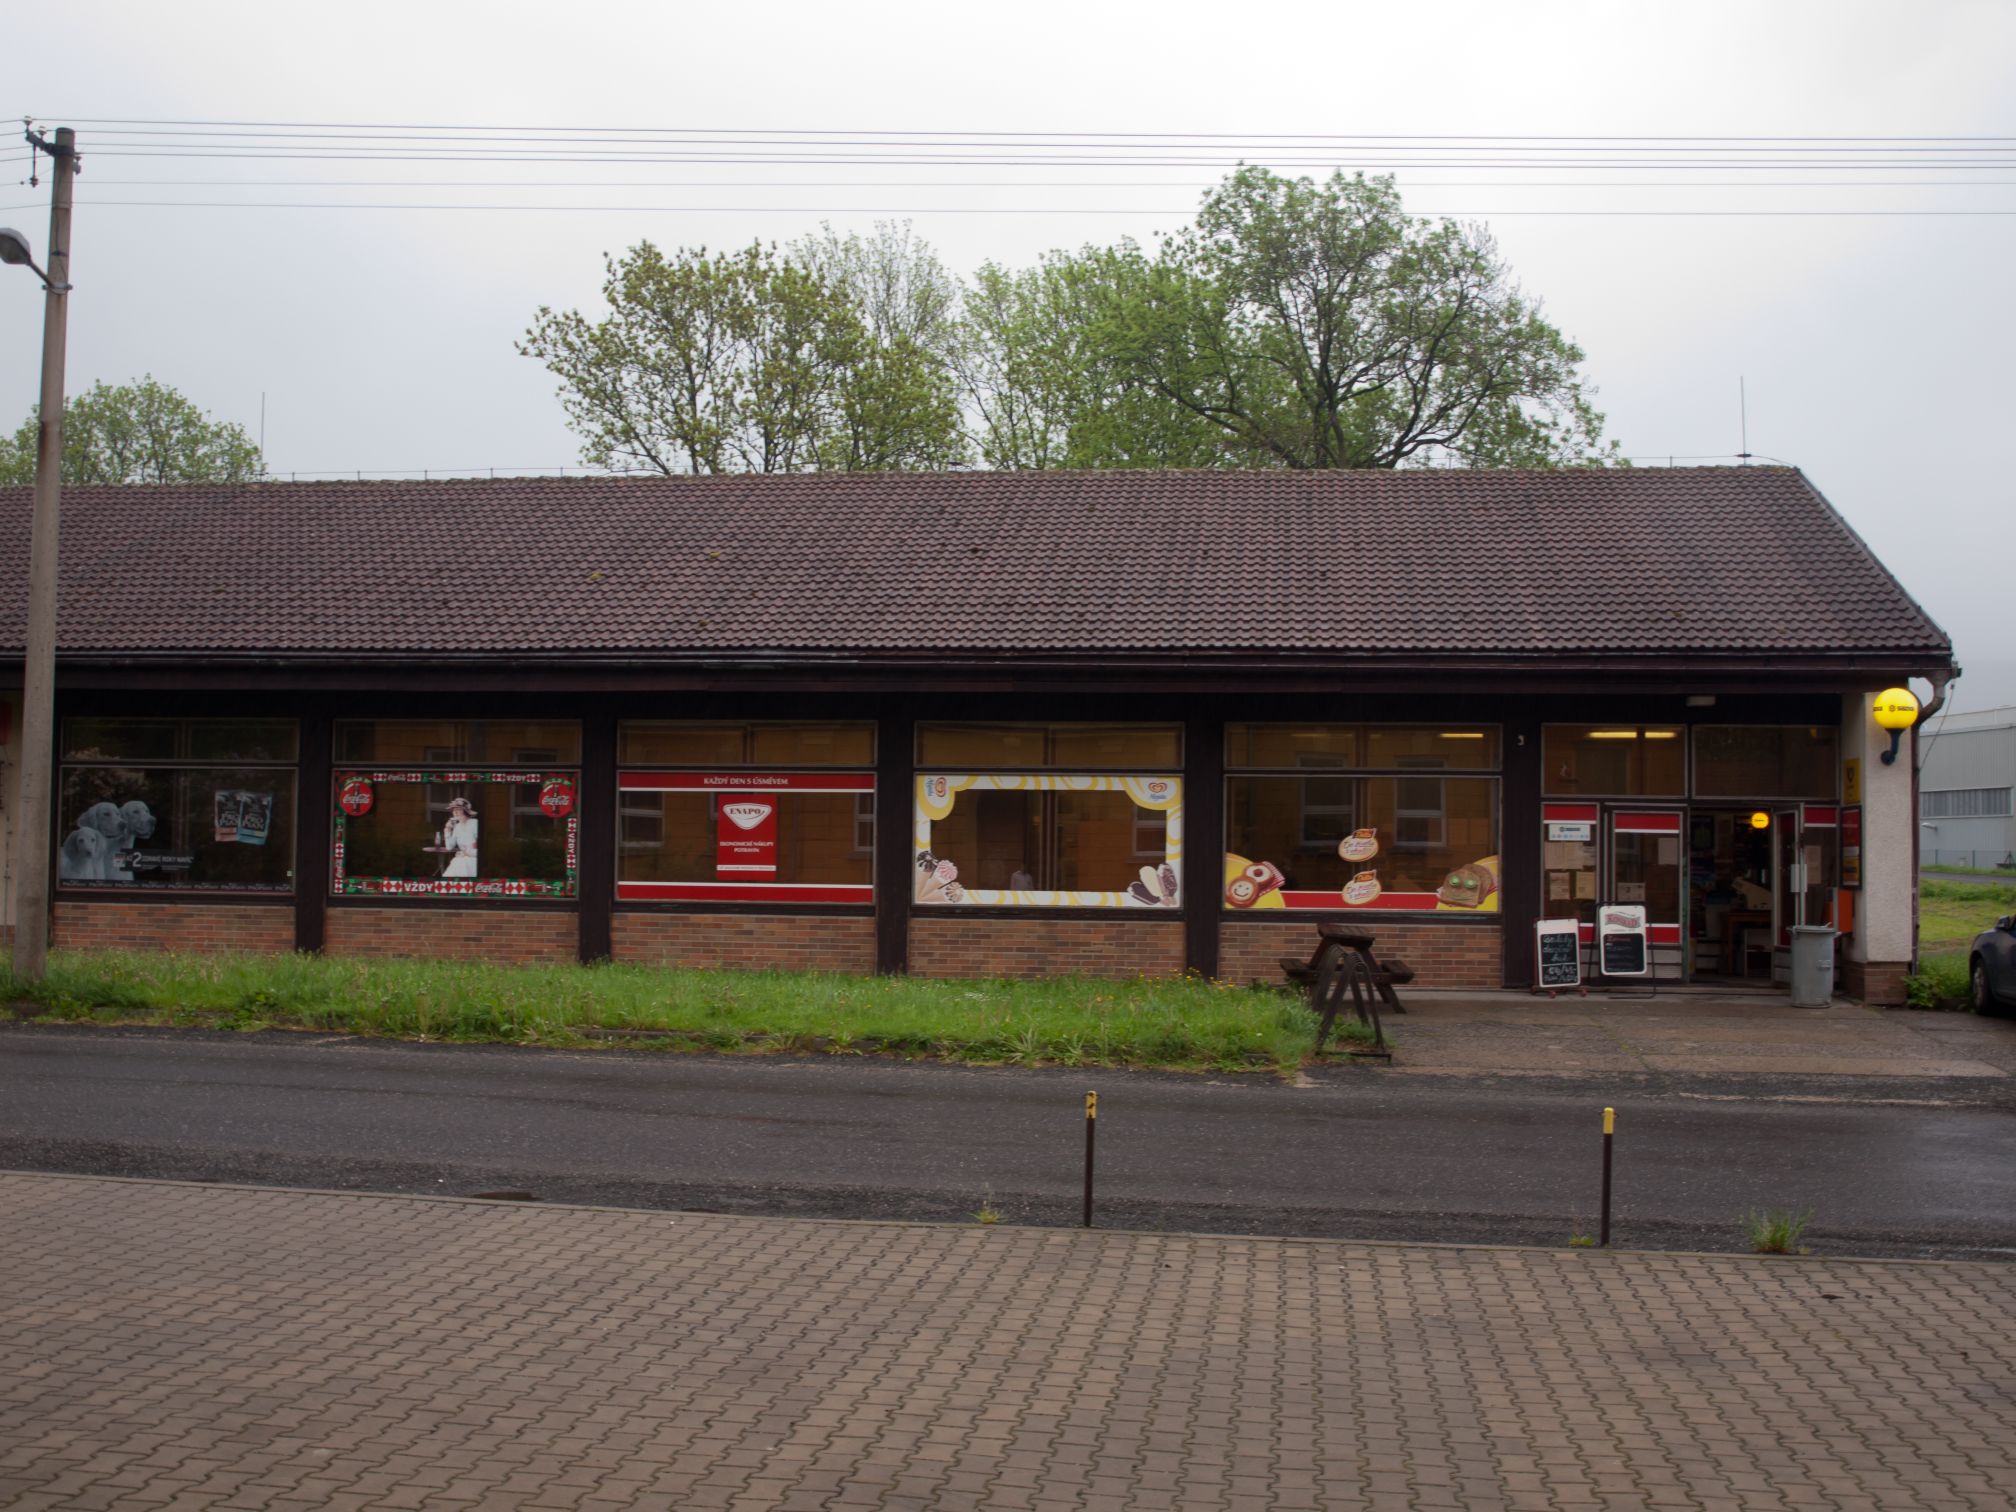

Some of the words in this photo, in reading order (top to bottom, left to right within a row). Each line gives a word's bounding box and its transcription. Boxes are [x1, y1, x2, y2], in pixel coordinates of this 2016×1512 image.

[729, 777, 745, 785] DEN
[730, 807, 761, 815] ENAPO
[132, 851, 142, 868] 2
[403, 881, 432, 892] VŽDY
